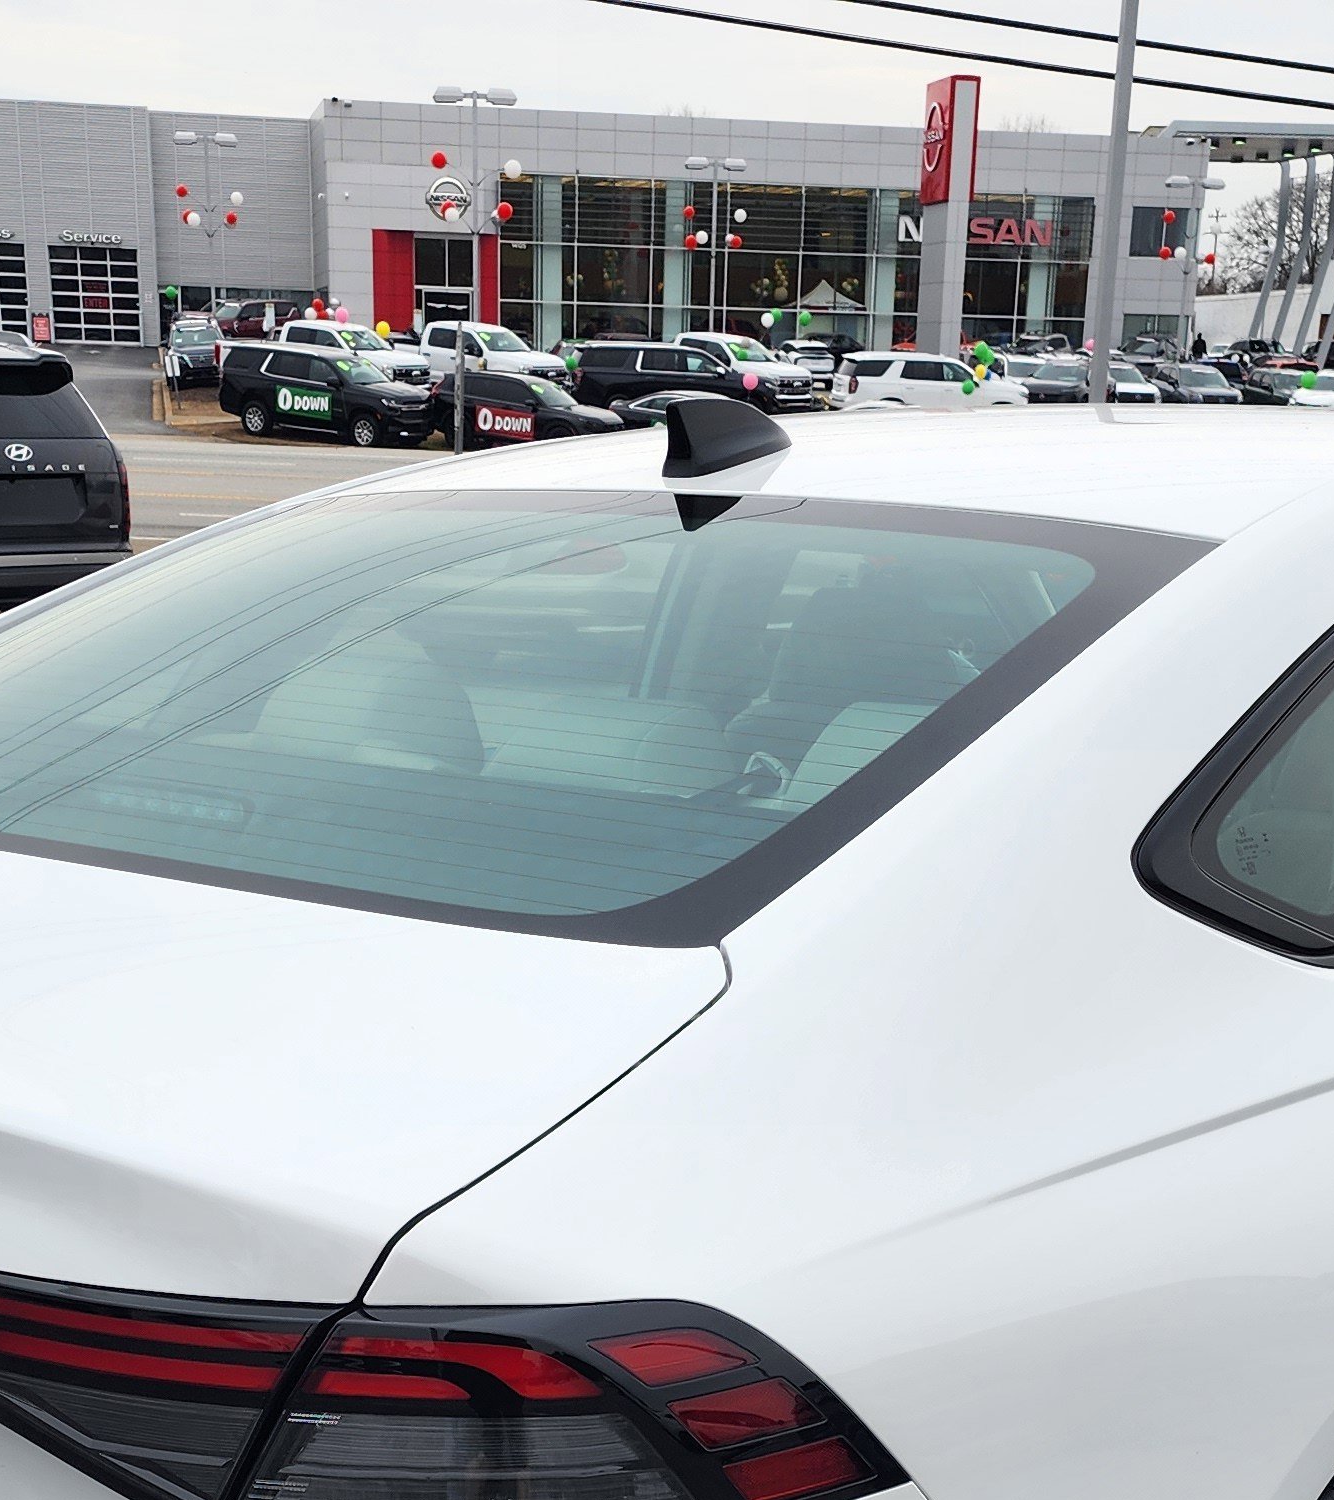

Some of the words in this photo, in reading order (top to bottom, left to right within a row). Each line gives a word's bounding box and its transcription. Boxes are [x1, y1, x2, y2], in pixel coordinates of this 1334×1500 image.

[61, 229, 123, 245] Service
[897, 214, 1053, 247] NSAN
[83, 297, 109, 308] ENTER
[293, 394, 329, 412] DOWN
[494, 414, 532, 433] DOWN
